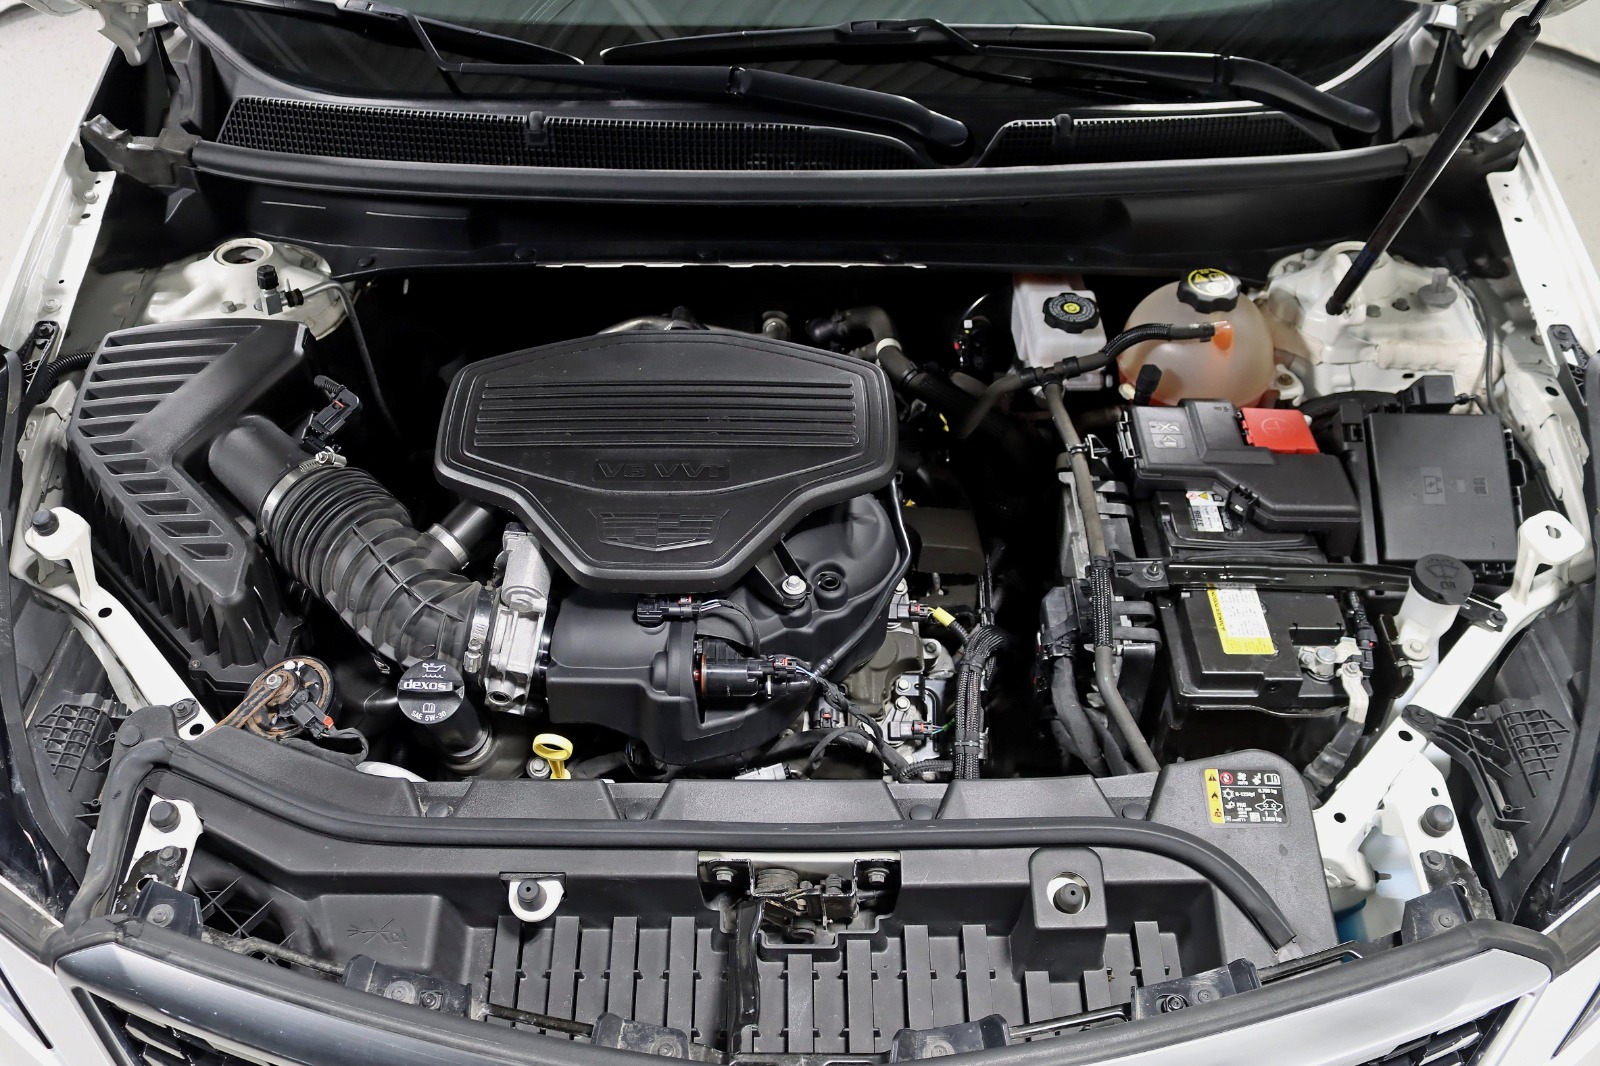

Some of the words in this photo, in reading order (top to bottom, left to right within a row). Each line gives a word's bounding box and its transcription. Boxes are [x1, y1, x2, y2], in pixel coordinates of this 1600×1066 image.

[598, 463, 646, 478] V6
[654, 463, 726, 478] VVT
[403, 679, 447, 691] dexos
[411, 710, 423, 720] SAE
[425, 711, 447, 722] 5W-30
